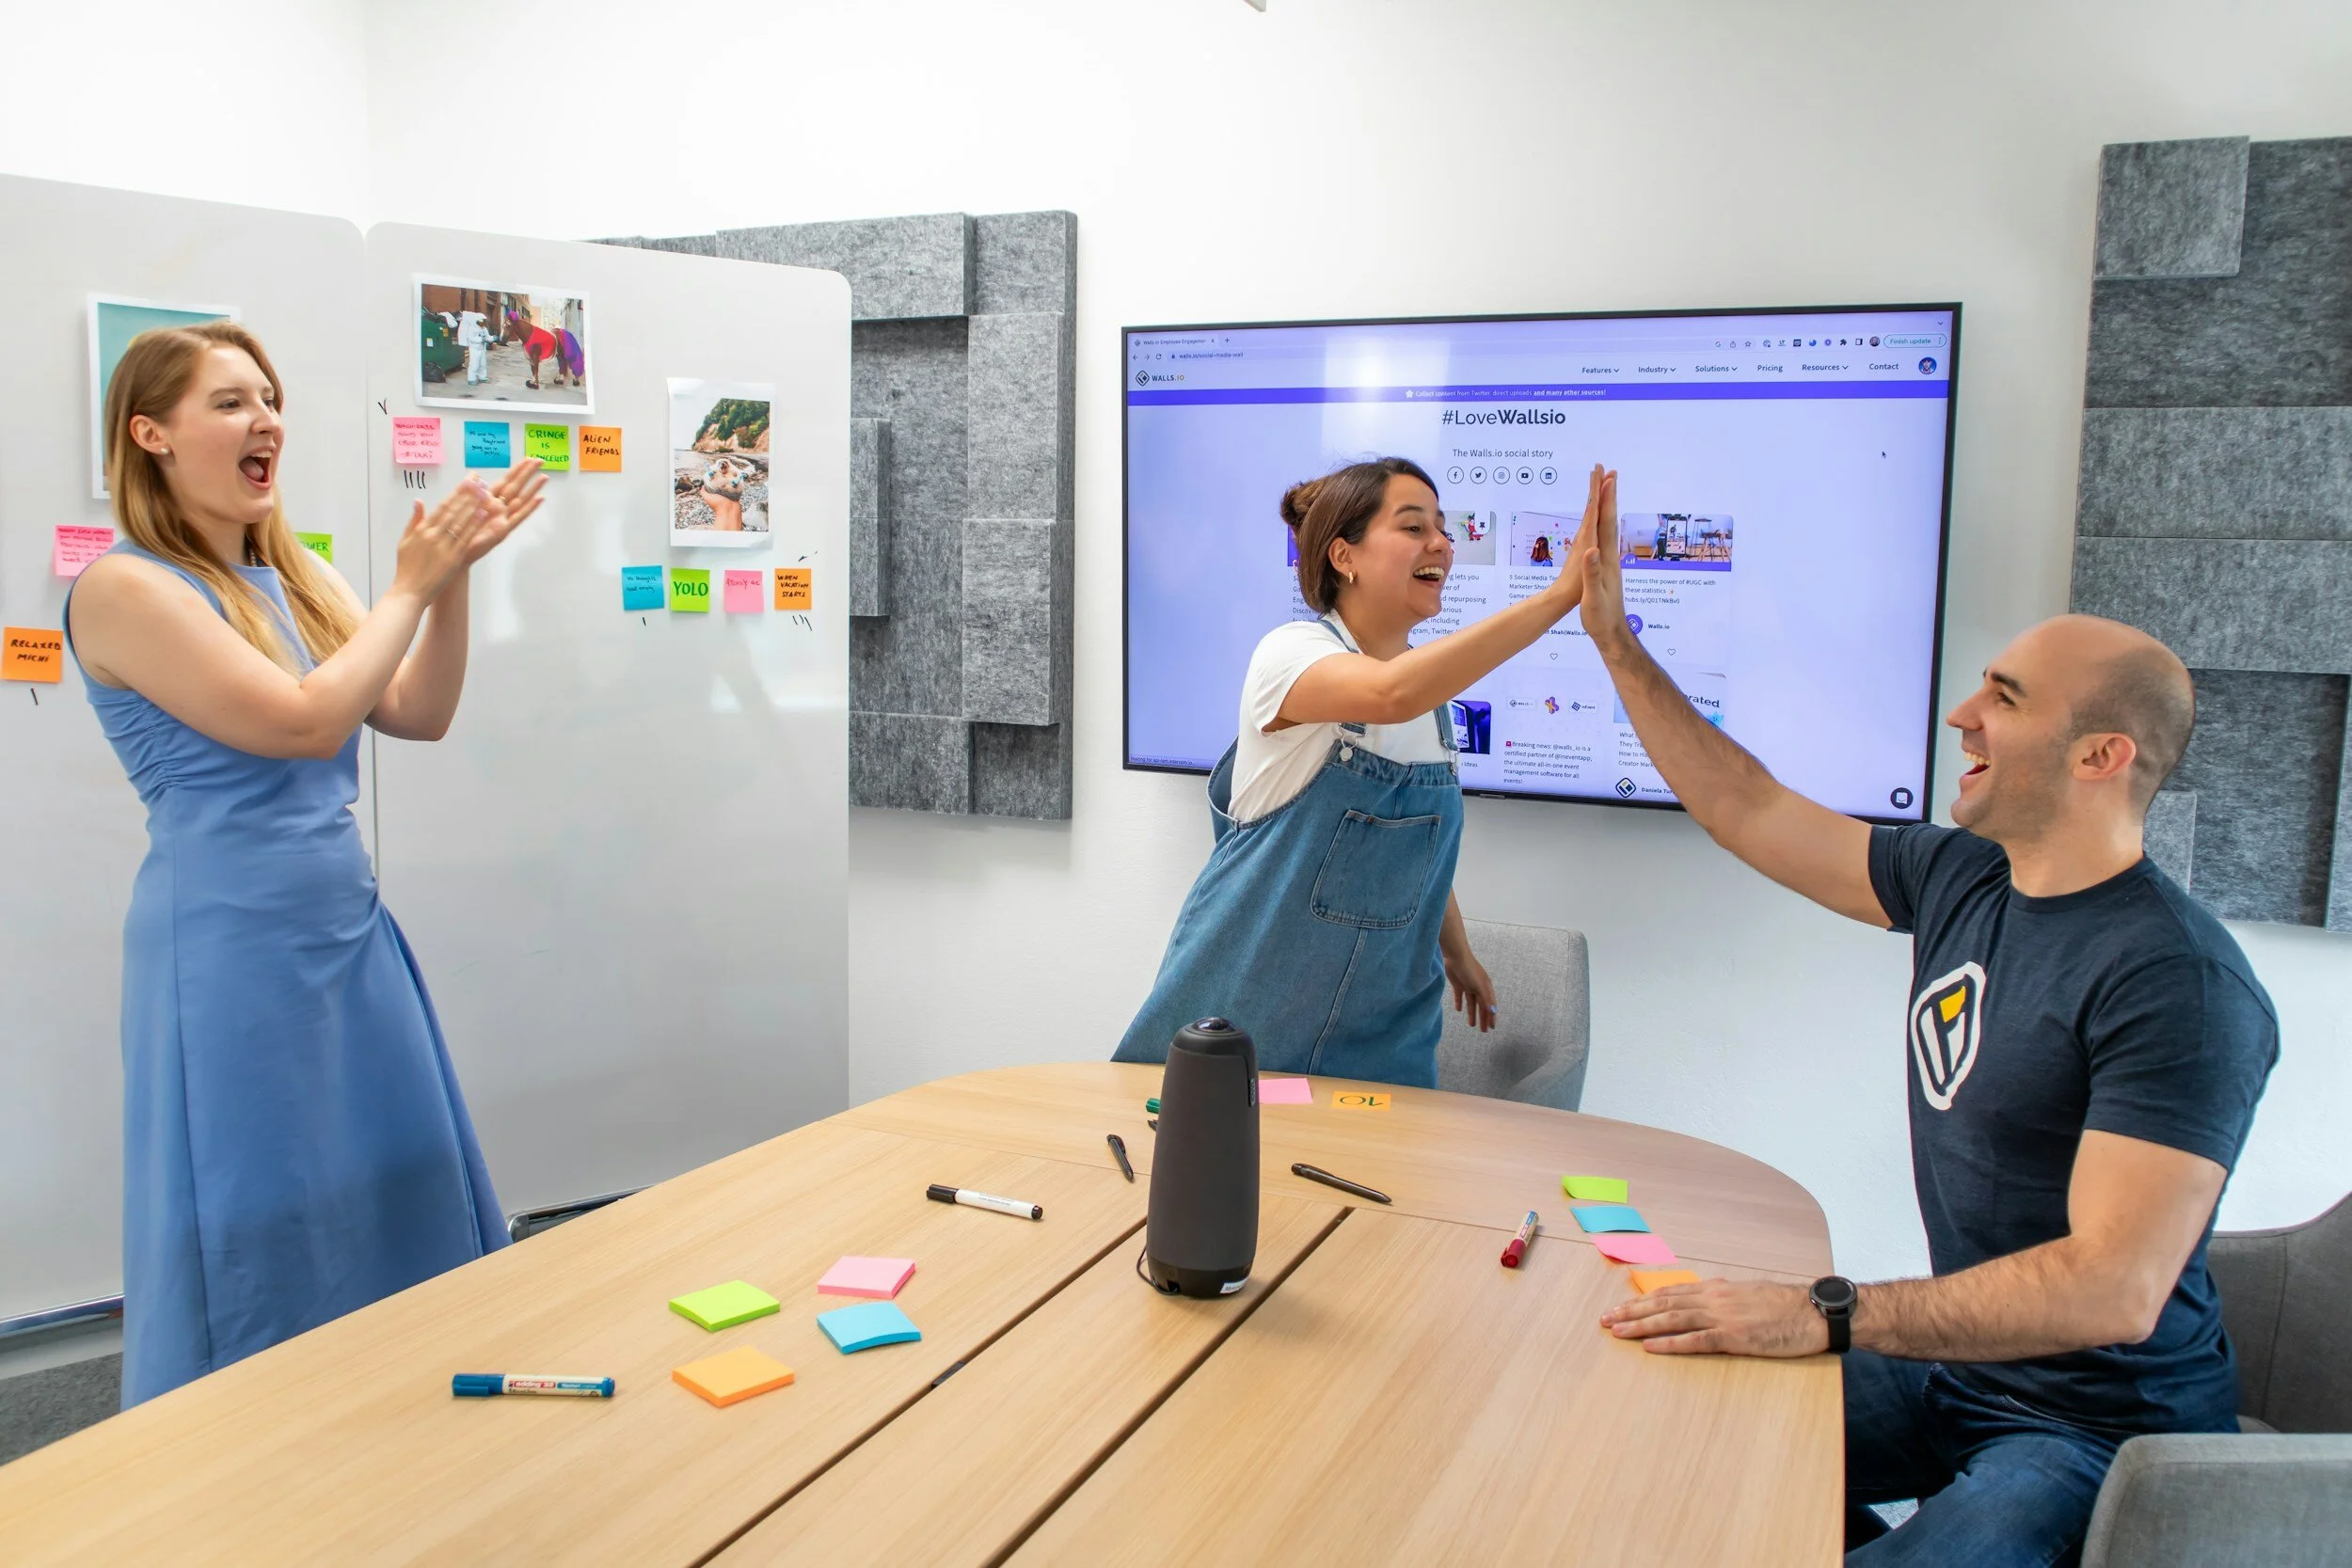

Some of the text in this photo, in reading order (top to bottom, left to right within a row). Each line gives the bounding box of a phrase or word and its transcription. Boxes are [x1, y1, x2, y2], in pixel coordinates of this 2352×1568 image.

[1909, 338, 1931, 346] update
[1638, 366, 1668, 374] Industry
[1757, 364, 1784, 372] Pricing
[1868, 362, 1899, 371] Contact
[1441, 408, 1566, 424] #LoveWallsio
[528, 430, 566, 439] CRINGE
[1453, 449, 1553, 460] The Walls.io social story
[673, 580, 708, 596] YOLO
[1448, 595, 1486, 604] repurposing
[1430, 617, 1460, 626] including
[10, 639, 61, 650] RELAXED
[1687, 695, 1720, 708] rated
[1512, 741, 1535, 750] Breaking
